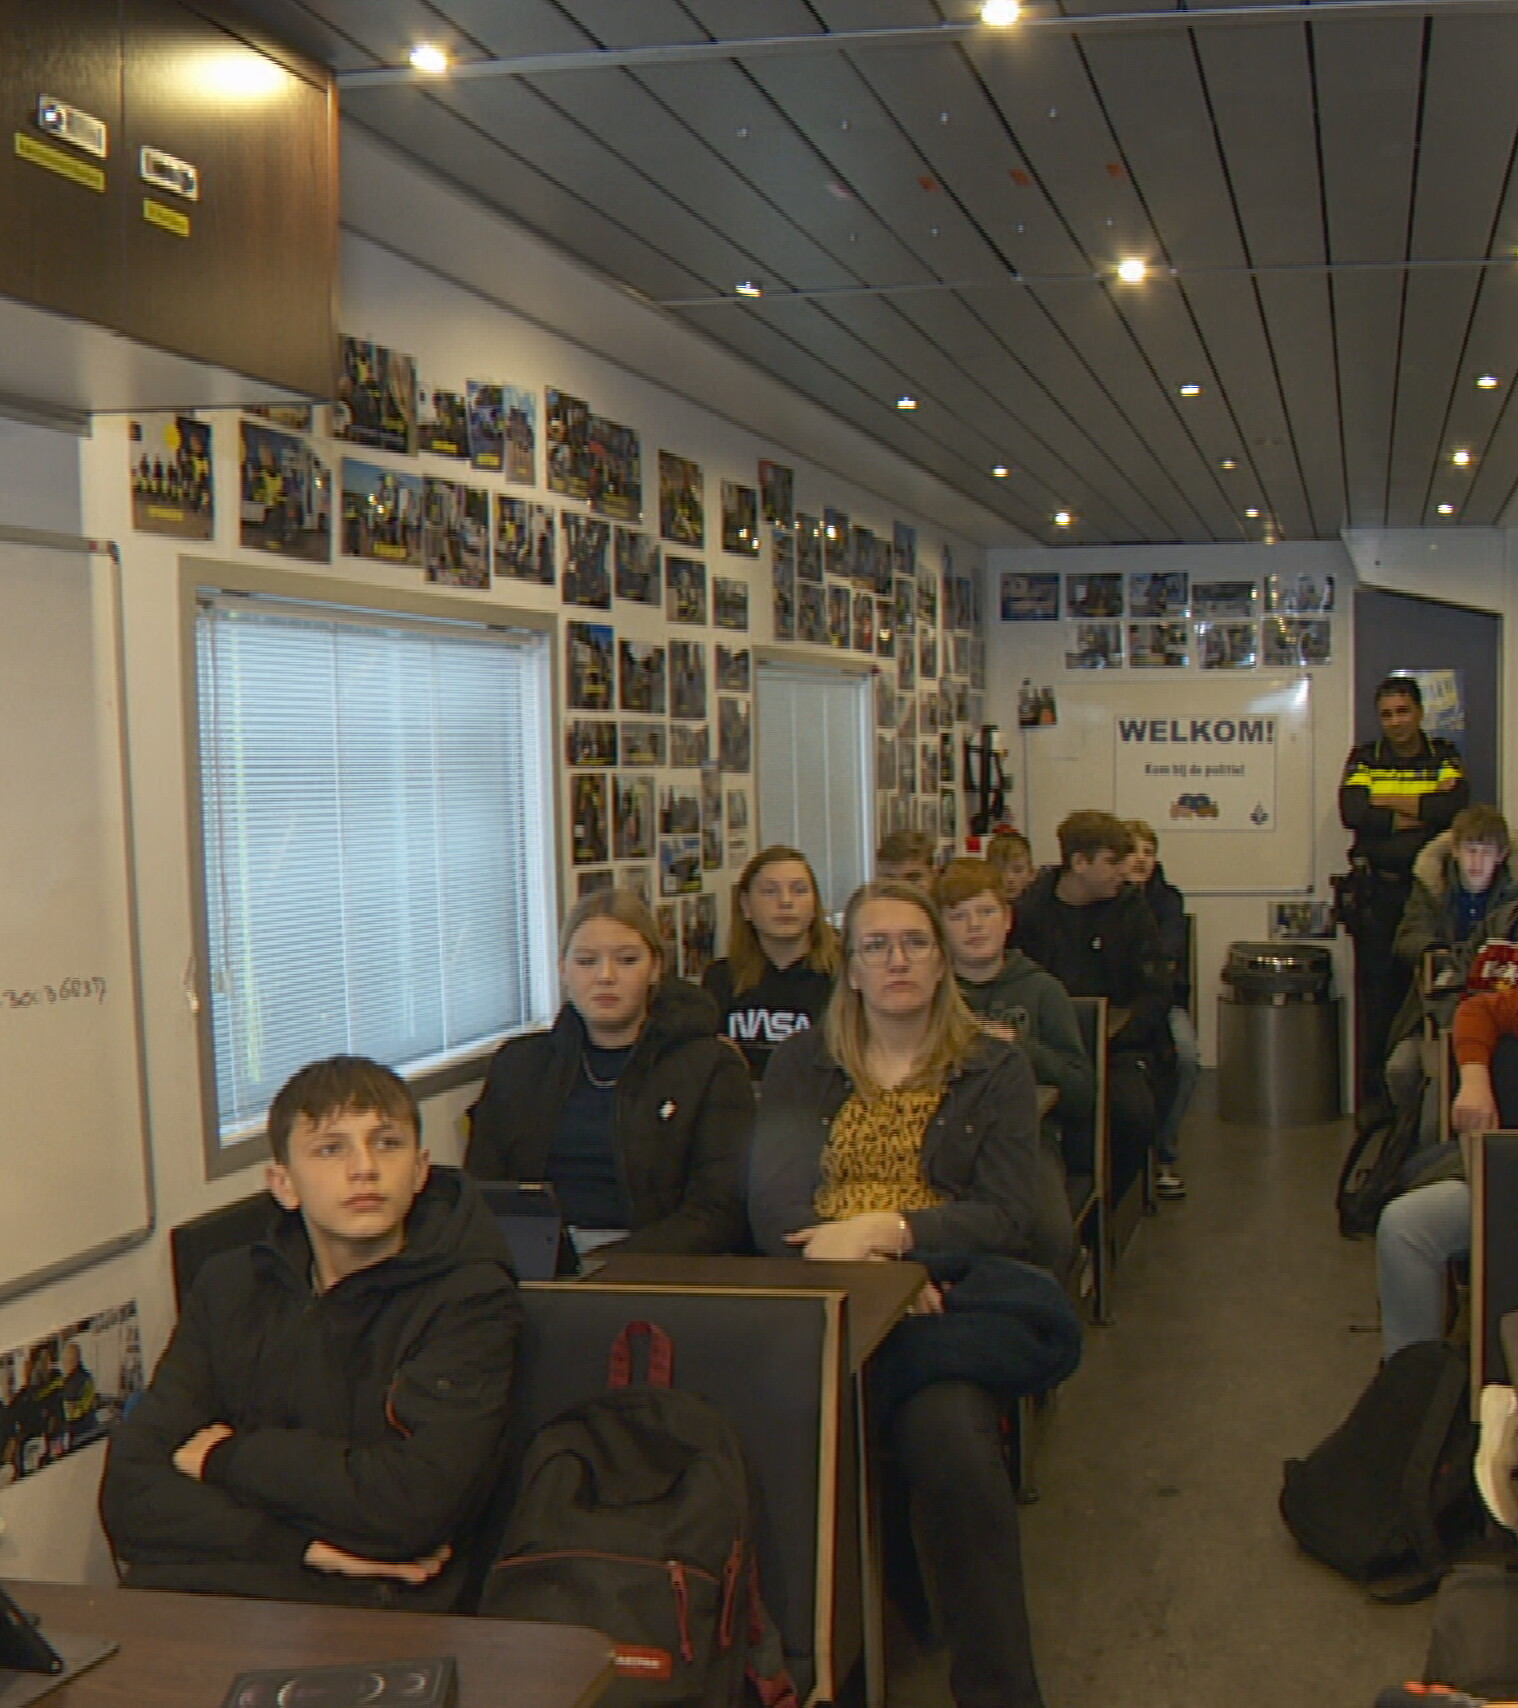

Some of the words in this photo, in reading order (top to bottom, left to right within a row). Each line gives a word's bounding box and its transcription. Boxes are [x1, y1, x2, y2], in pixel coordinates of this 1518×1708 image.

[1118, 720, 1274, 743] WELKOM!
[1145, 764, 1170, 774] Kom
[729, 1009, 810, 1041] NASA
